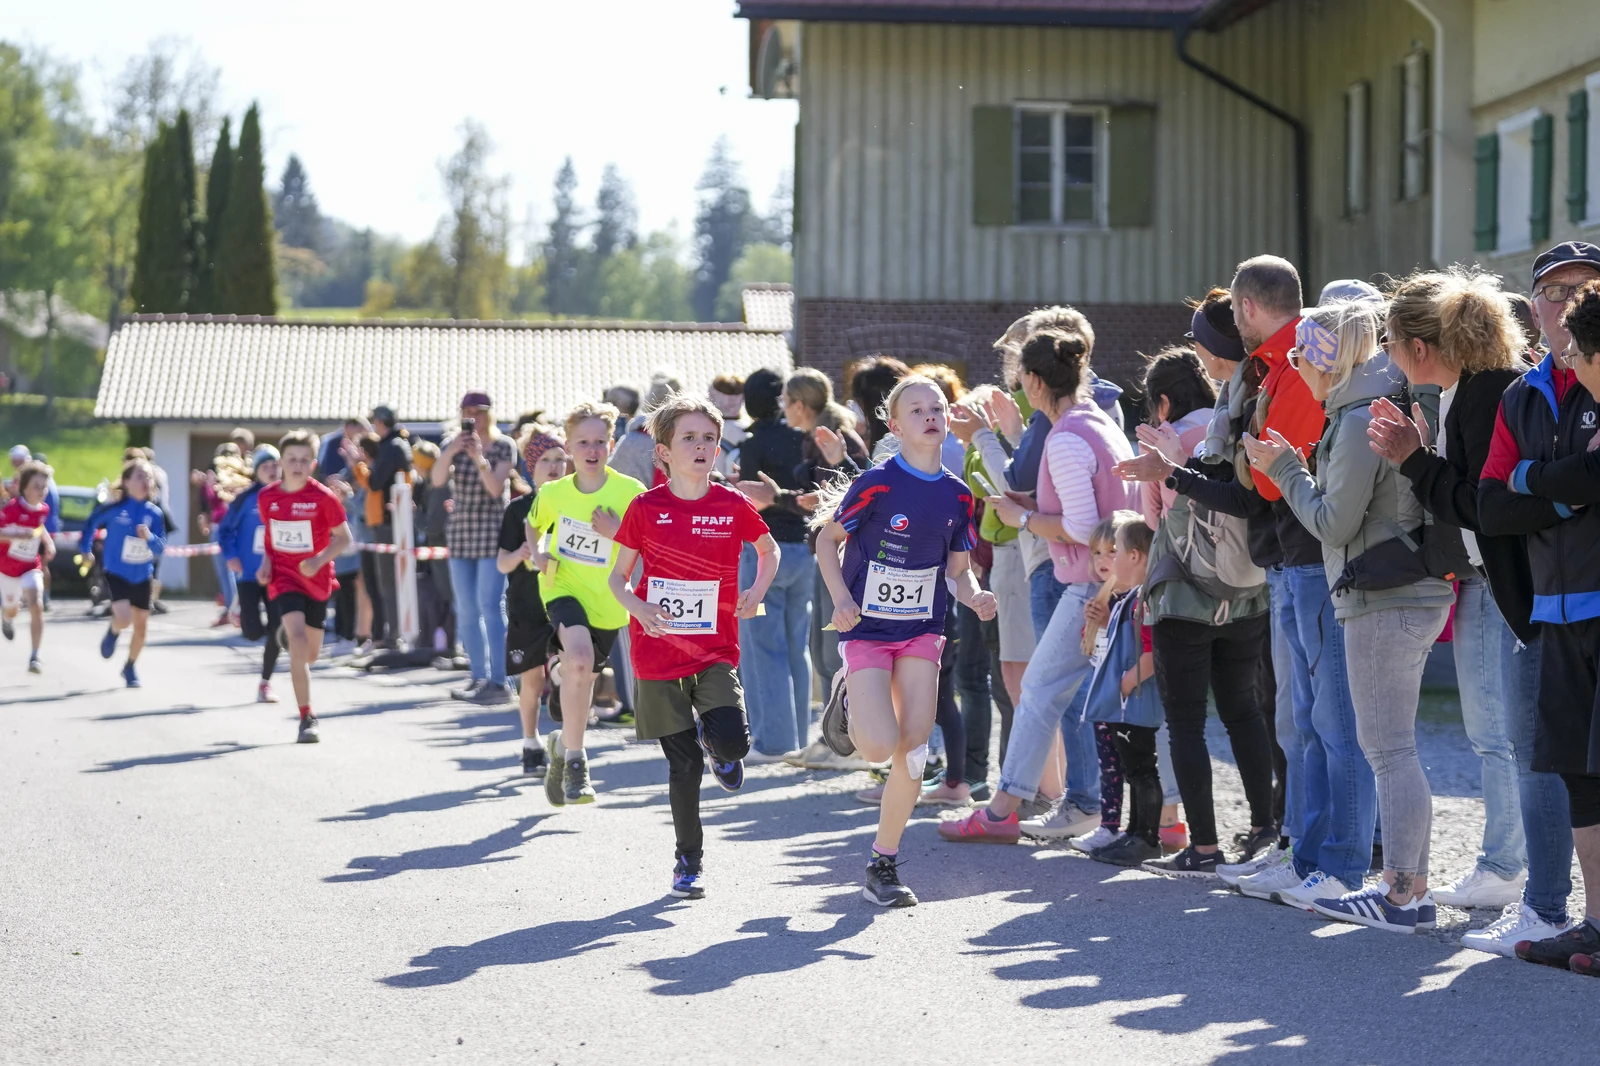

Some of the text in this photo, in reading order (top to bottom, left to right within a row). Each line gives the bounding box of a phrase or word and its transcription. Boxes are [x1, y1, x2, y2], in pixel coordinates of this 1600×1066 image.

[692, 516, 734, 525] PFAFF
[566, 533, 599, 554] 47-1
[878, 582, 924, 604] 93-1
[659, 597, 703, 618] 63-1
